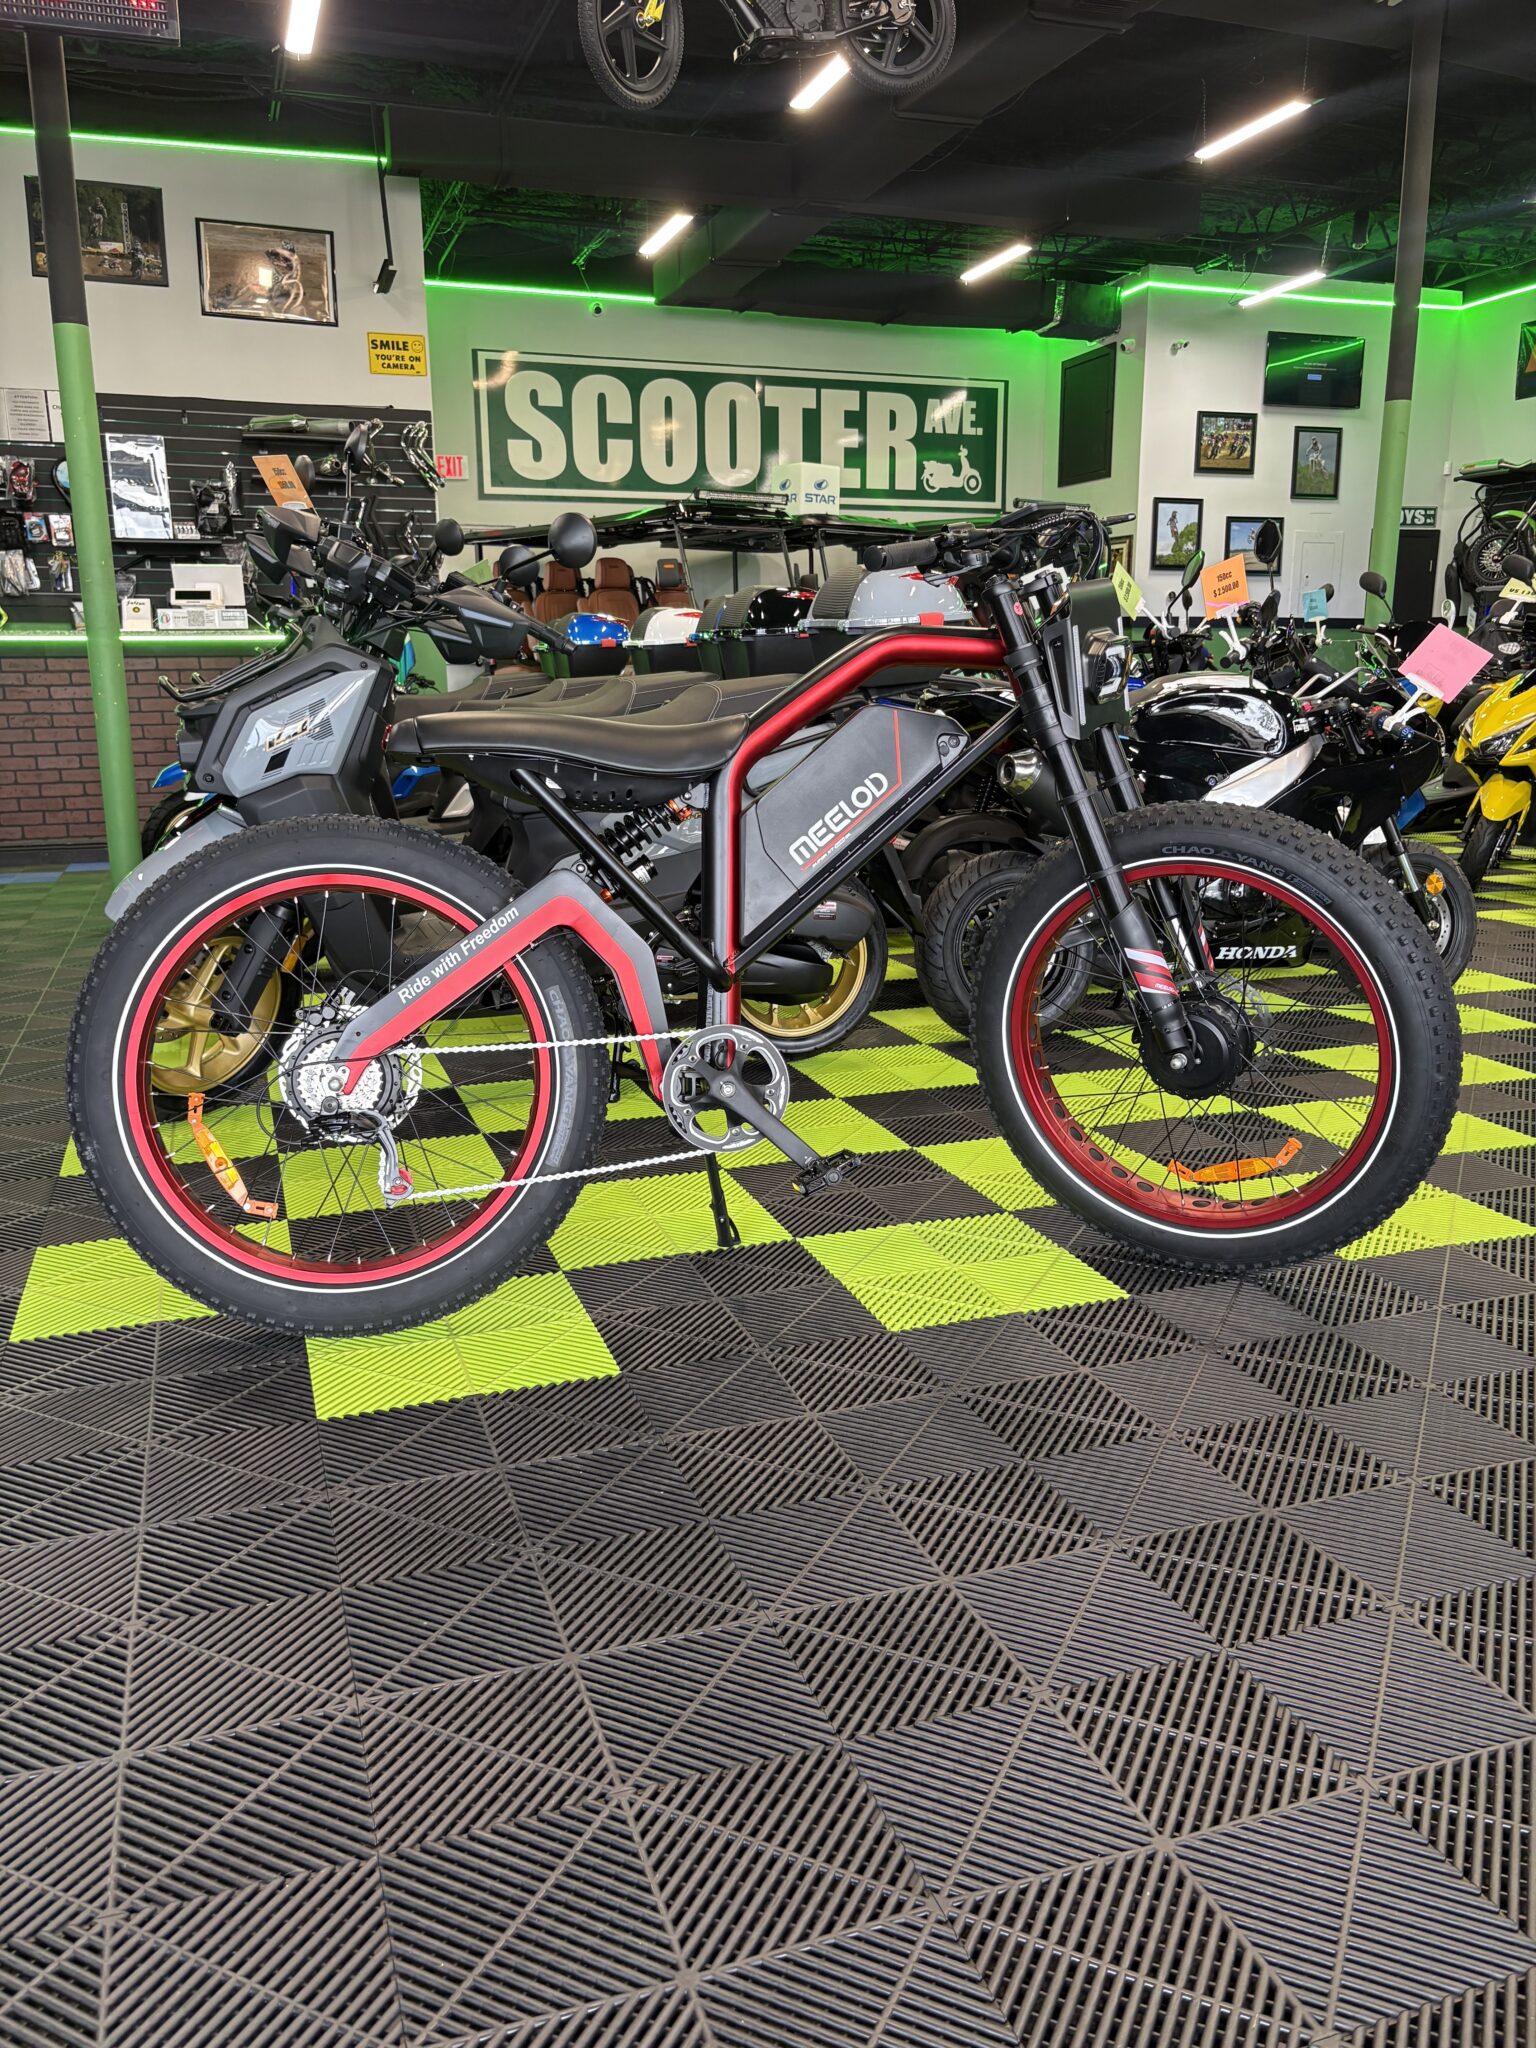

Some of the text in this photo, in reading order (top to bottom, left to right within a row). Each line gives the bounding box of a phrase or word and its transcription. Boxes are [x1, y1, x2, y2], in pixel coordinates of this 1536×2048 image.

[371, 339, 409, 351] SMILE
[375, 354, 405, 362] YOU'RE
[381, 362, 415, 370] CAMERA
[504, 370, 983, 490] SCOOTER AVE.
[436, 455, 463, 478] EXIT
[804, 493, 836, 504] STAR
[1217, 571, 1232, 582] 150cc
[788, 772, 888, 866] MEELOD
[1161, 846, 1285, 877] CHAO YANG
[397, 907, 520, 1004] Ride with Freedom
[1215, 945, 1297, 960] HONDA
[549, 990, 570, 1041] CHAO
